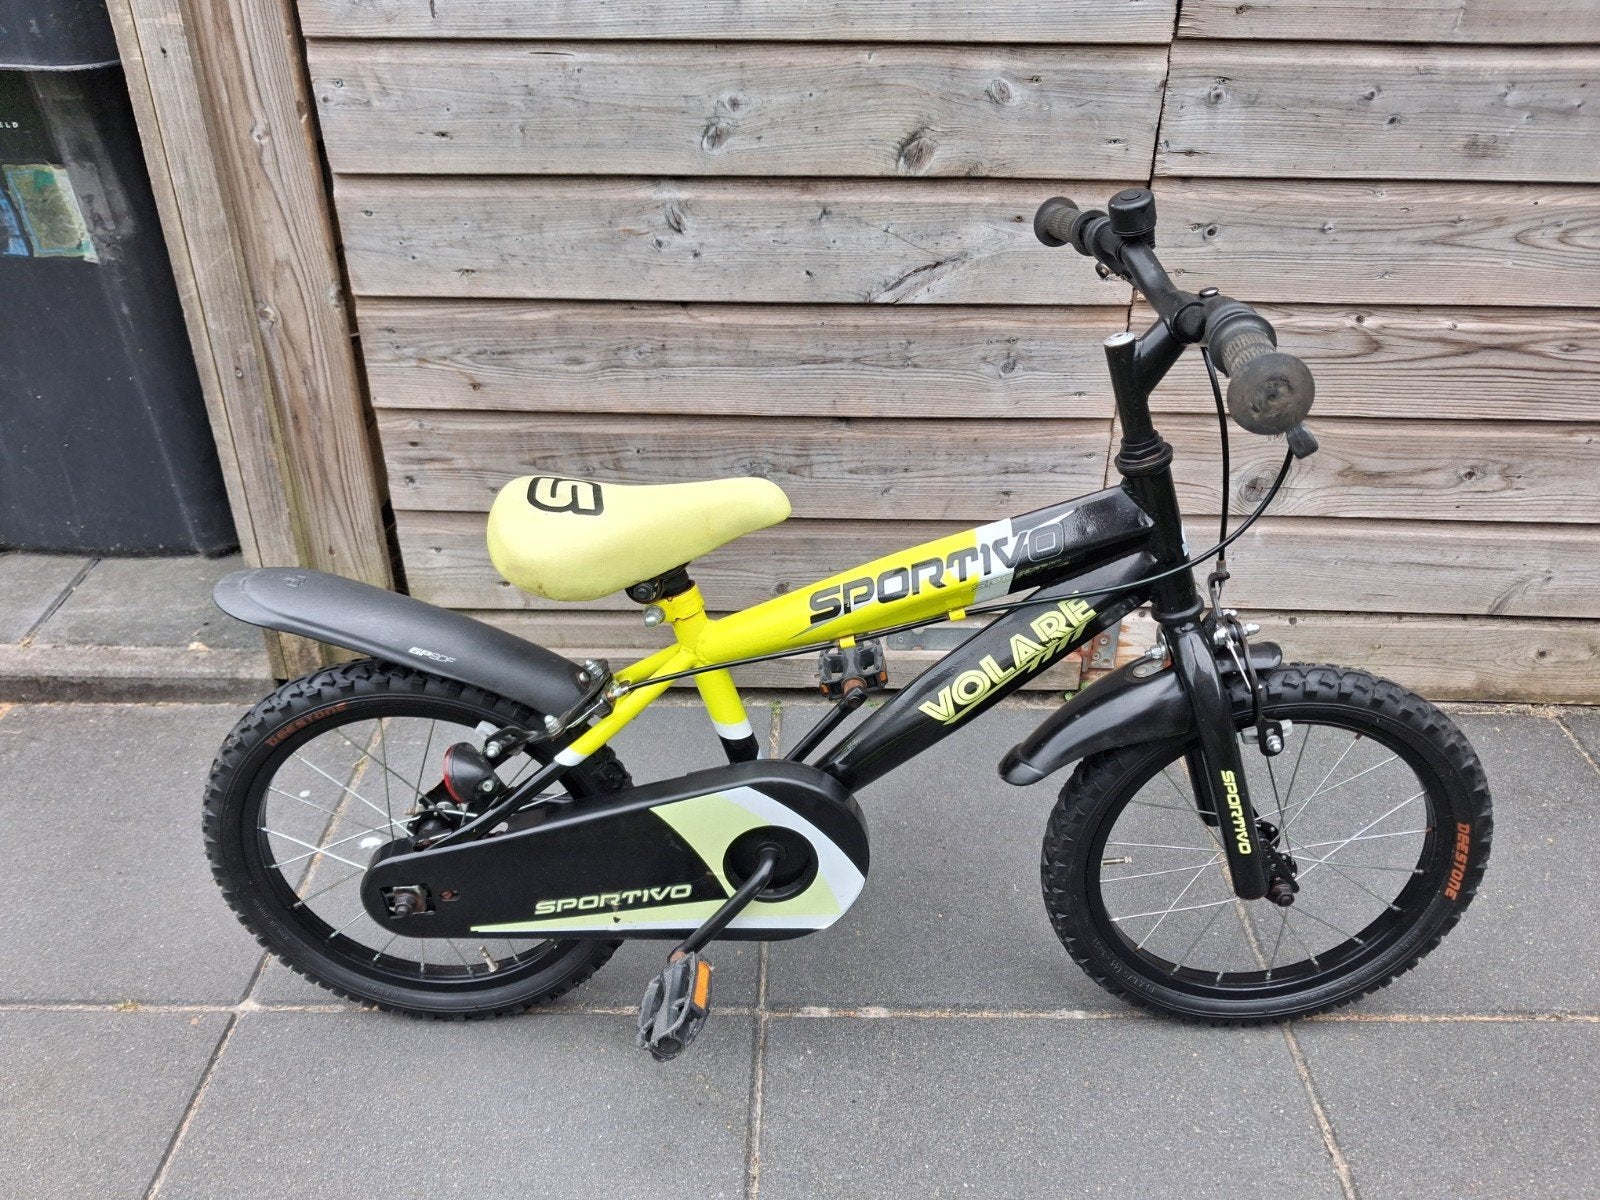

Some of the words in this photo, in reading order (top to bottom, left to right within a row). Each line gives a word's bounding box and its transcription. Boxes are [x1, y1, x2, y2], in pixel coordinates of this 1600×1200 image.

[809, 520, 1066, 625] SPORTIVO
[918, 590, 1097, 723] VOLARE
[1220, 769, 1253, 855] SPORTIVO
[533, 883, 693, 916] SPORTIVO
